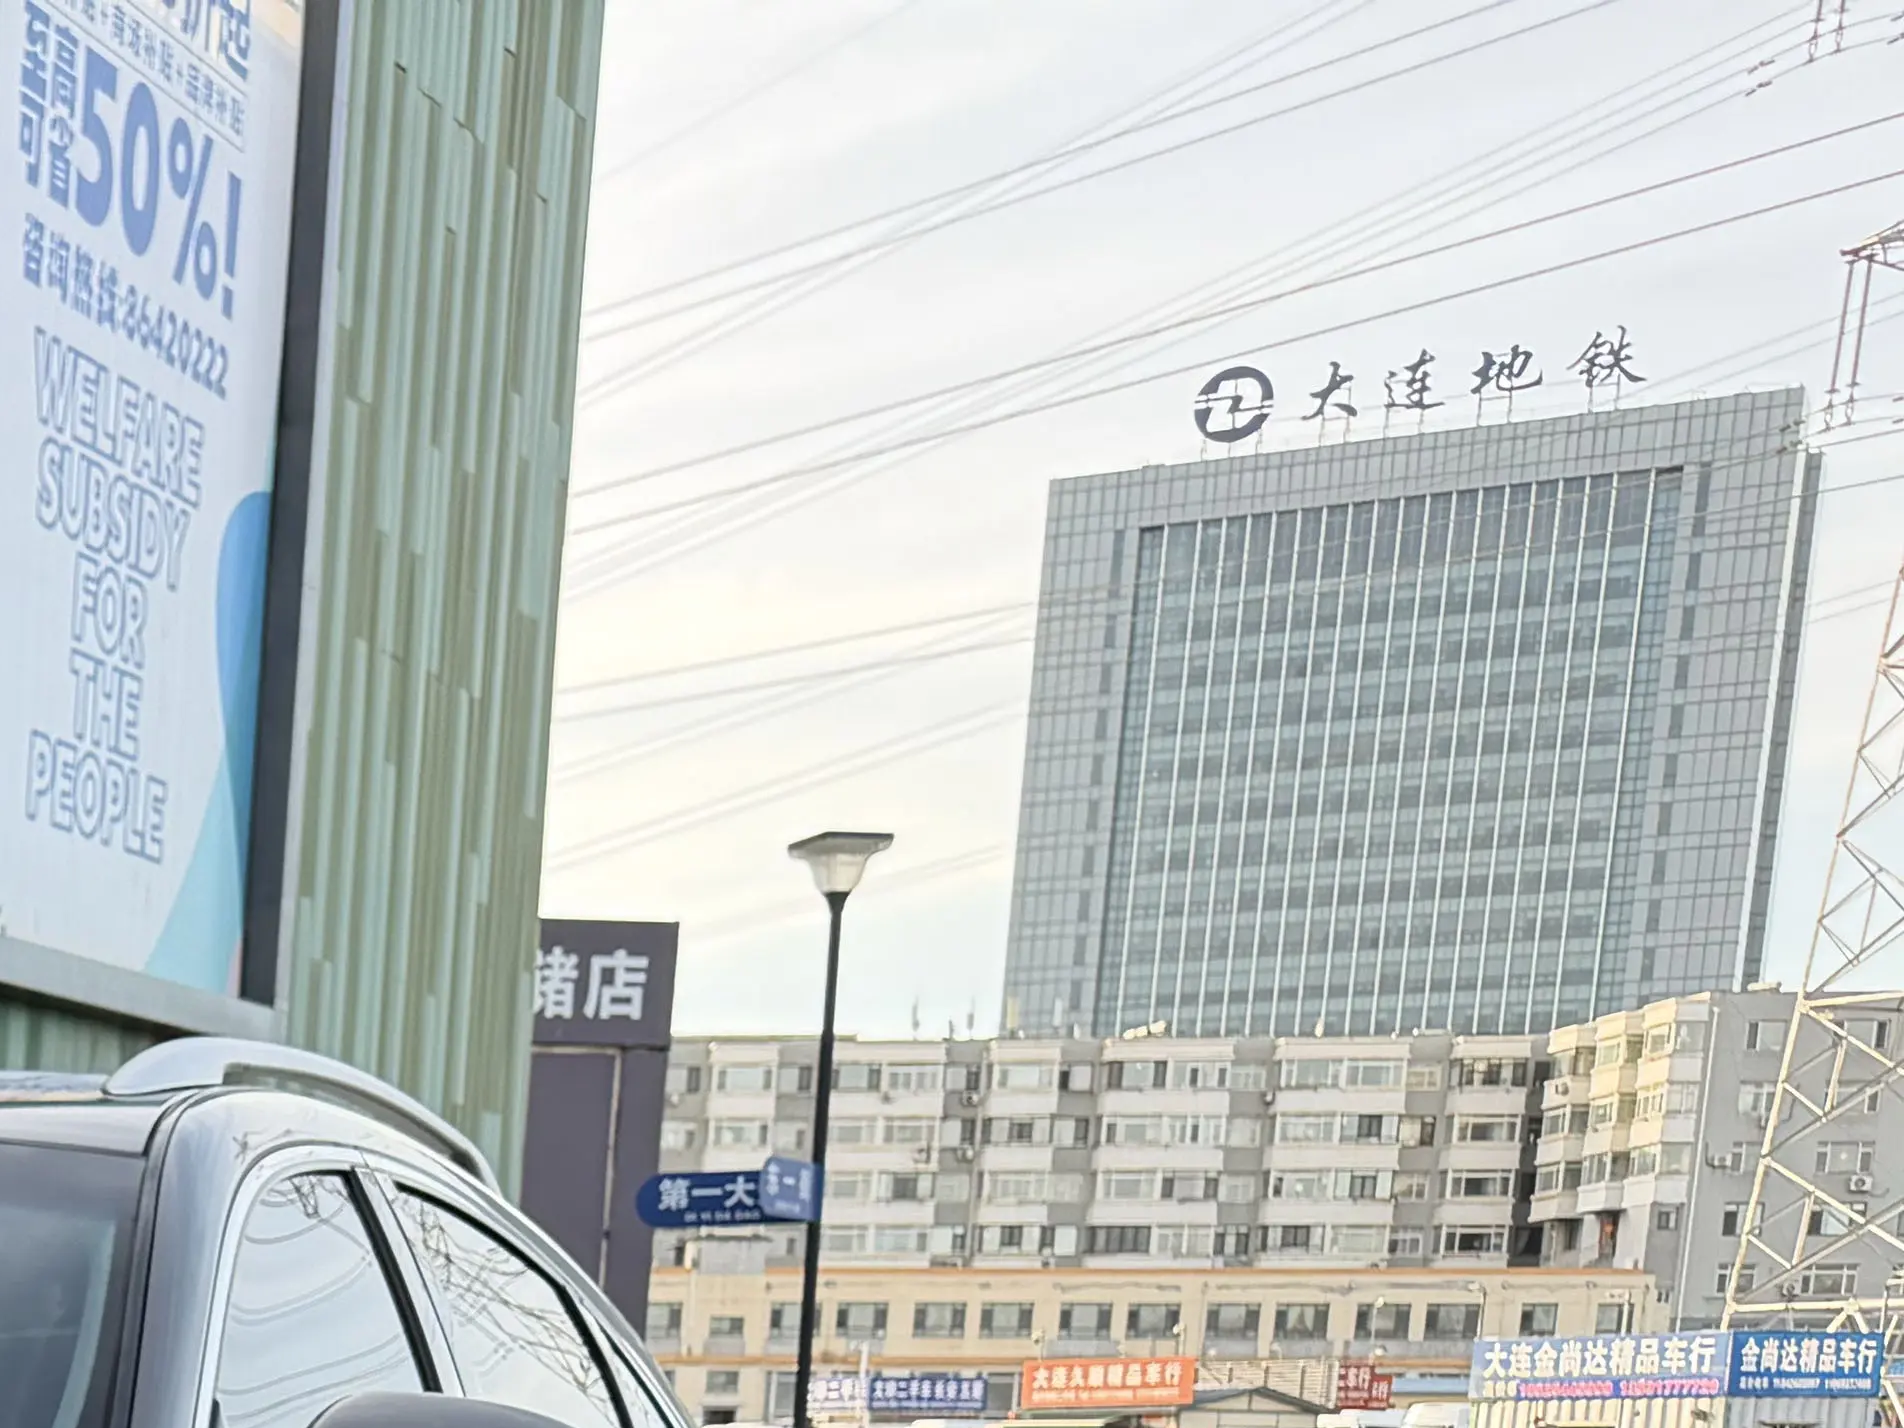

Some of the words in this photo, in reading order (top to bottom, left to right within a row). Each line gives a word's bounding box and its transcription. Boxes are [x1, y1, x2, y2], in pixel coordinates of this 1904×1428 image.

[75, 45, 243, 321] 50%!
[34, 326, 205, 509] WELFARE
[1300, 325, 1647, 421] 大连地铁
[36, 436, 191, 592] SUBSIDY
[71, 551, 148, 671] FOR
[69, 647, 143, 762] THE
[25, 728, 168, 864] PEOPLE
[1483, 1336, 1716, 1378] 大连金尚达精品车行
[1740, 1336, 1877, 1374] 金尚达精品车行
